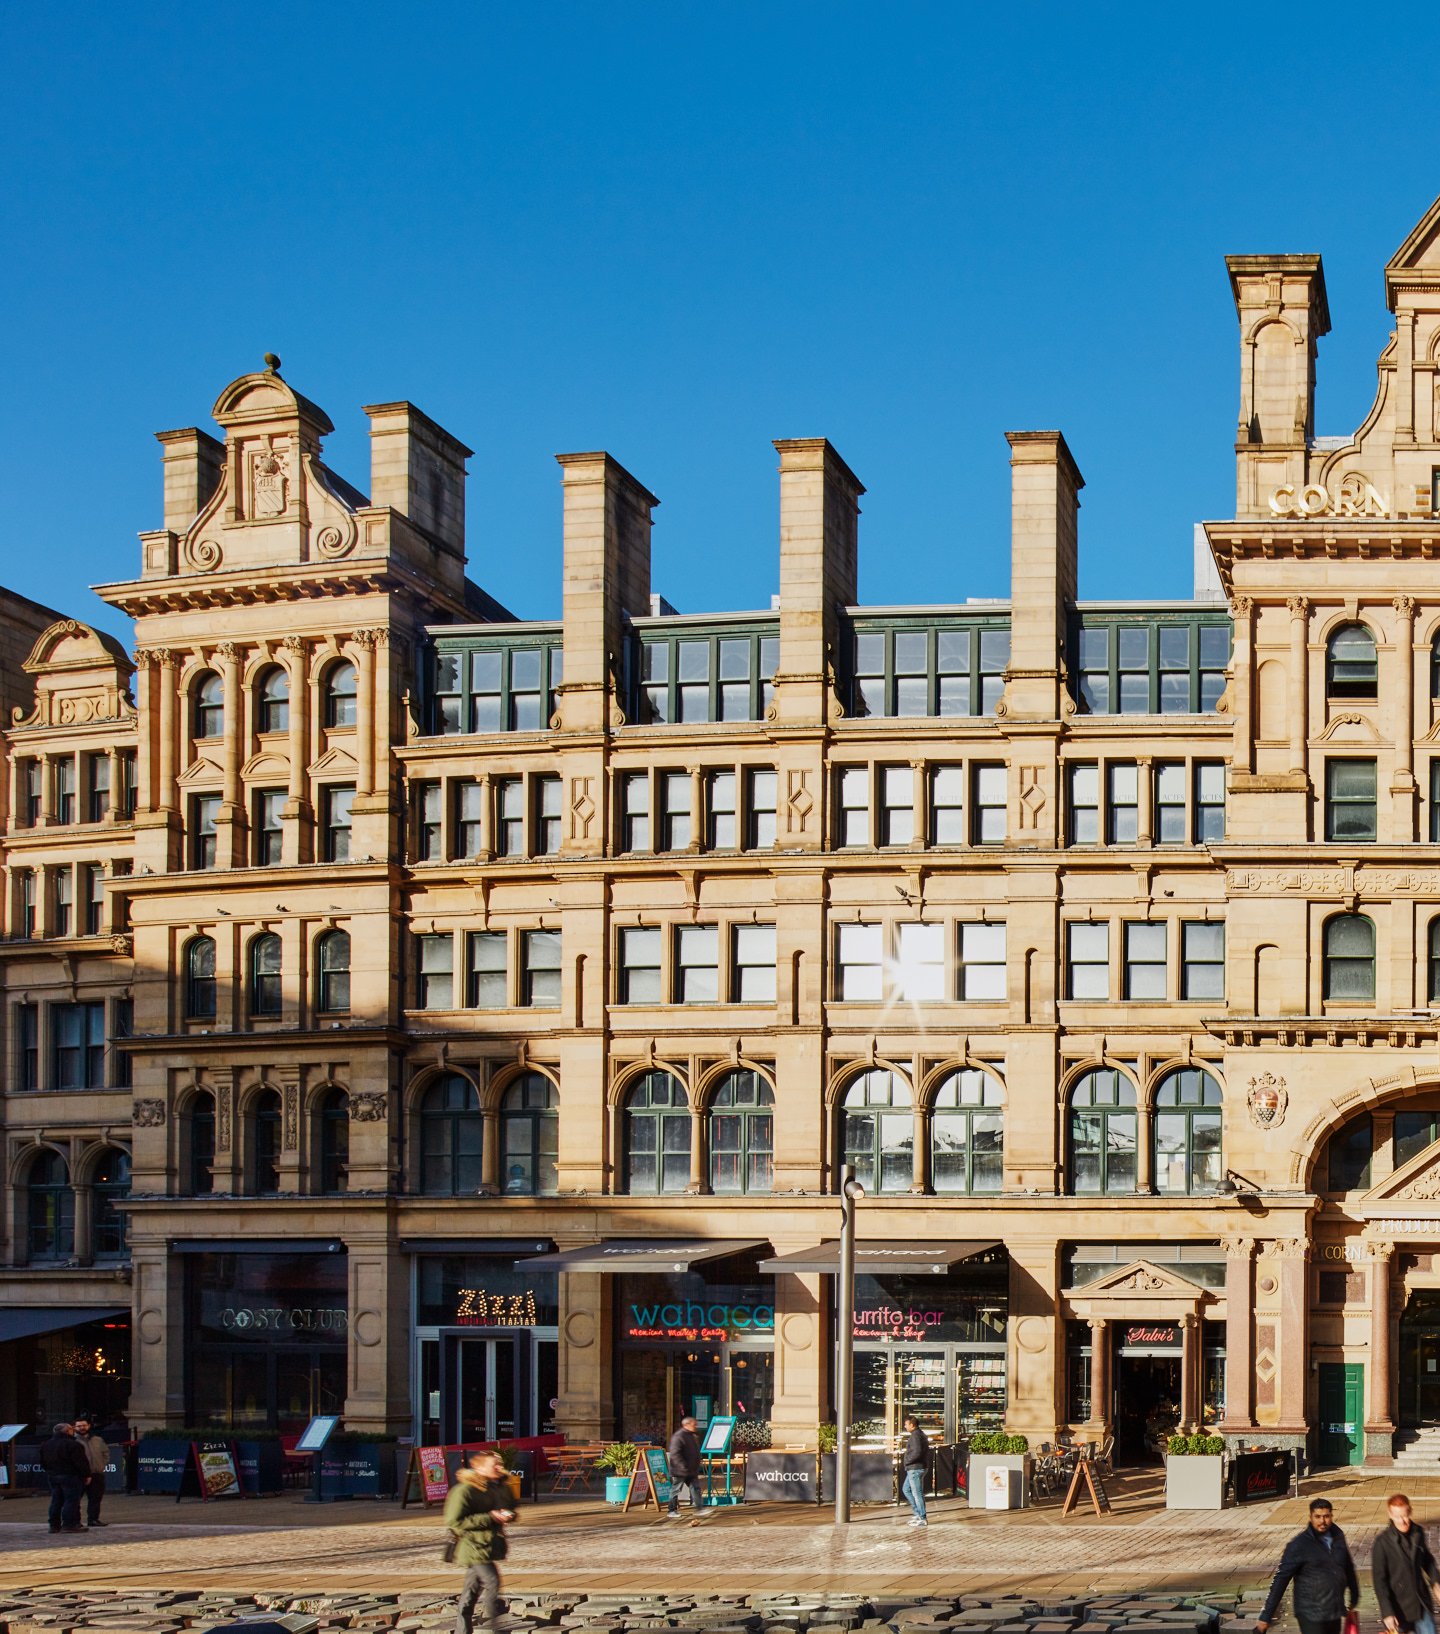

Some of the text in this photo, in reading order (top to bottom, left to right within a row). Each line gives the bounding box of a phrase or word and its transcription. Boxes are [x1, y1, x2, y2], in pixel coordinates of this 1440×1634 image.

[1268, 483, 1391, 514] CORN
[1325, 1246, 1362, 1260] CORN
[457, 1288, 536, 1317] Zizzi
[222, 1308, 348, 1330] COSY CLUB
[630, 1298, 775, 1328] wahaca
[853, 1306, 945, 1326] urrito bar
[1127, 1327, 1174, 1345] Salvi's
[203, 1442, 227, 1450] Zizzi
[755, 1469, 809, 1482] wahaca
